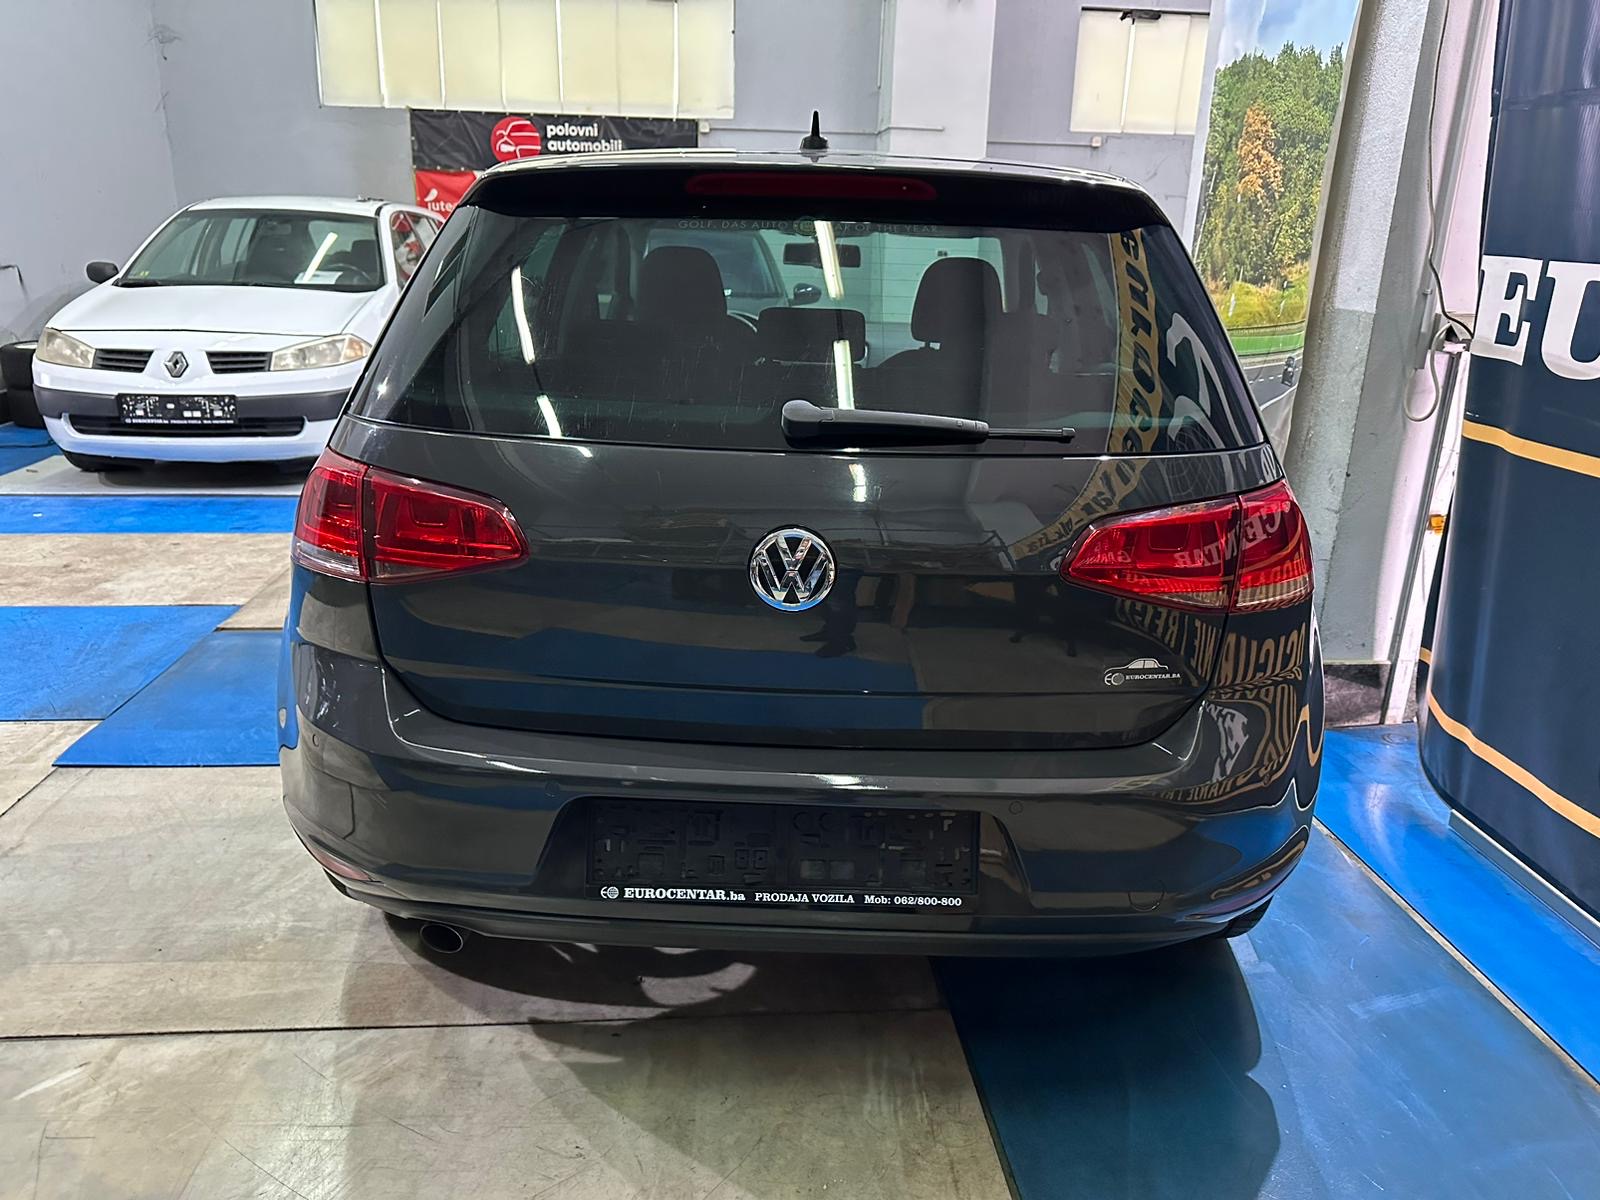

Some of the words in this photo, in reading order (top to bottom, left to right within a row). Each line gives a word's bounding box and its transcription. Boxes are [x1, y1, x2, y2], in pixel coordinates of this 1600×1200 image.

[546, 122, 599, 138] polovni
[547, 139, 622, 152] automobili
[623, 887, 746, 901] EUROCENTAR.ba
[754, 892, 810, 903] PRODAJA
[812, 893, 855, 904] VOZILA
[864, 894, 892, 905] Mob:
[893, 896, 962, 907] 062/800-800
